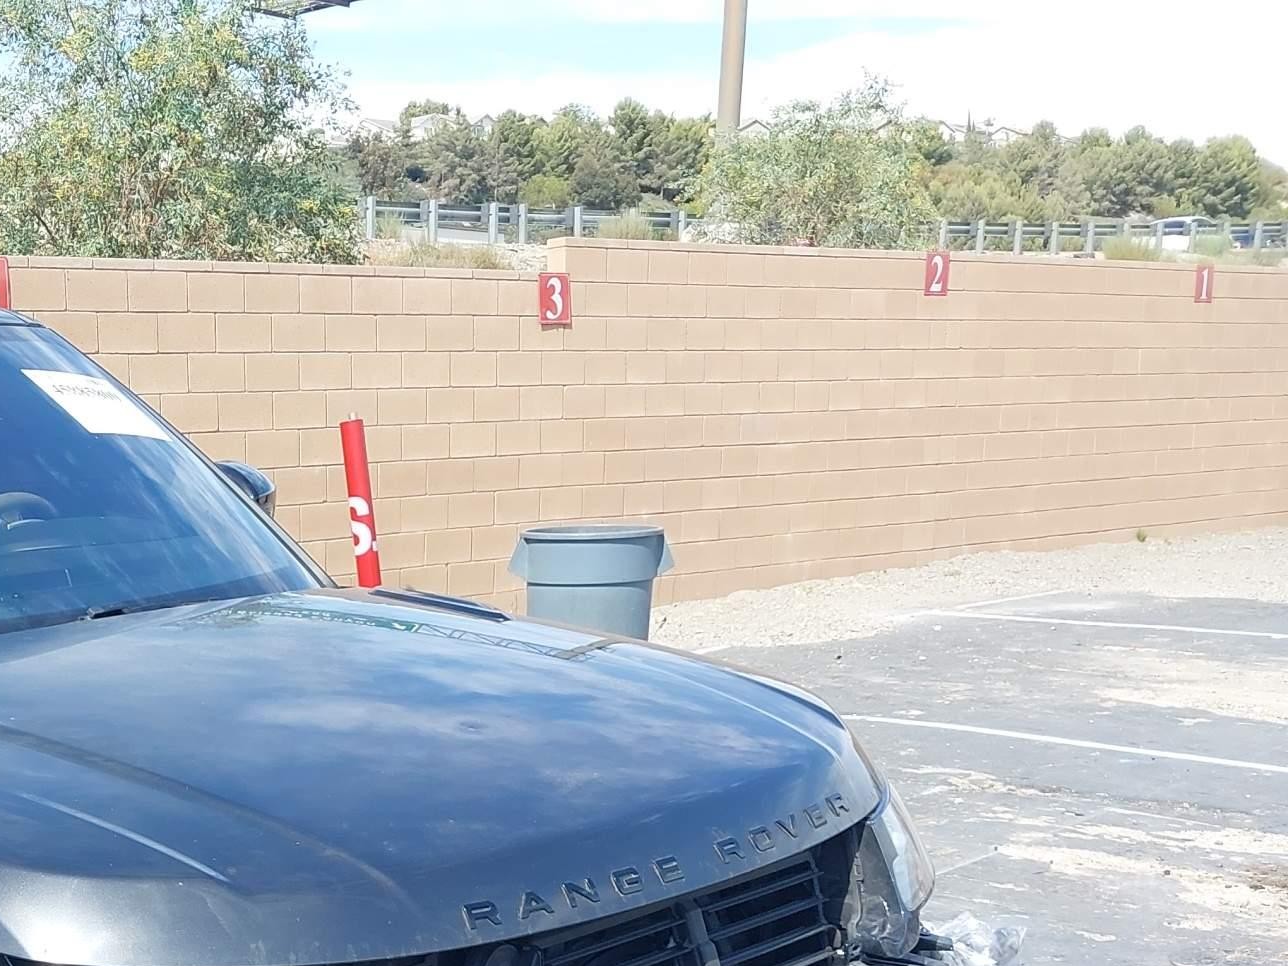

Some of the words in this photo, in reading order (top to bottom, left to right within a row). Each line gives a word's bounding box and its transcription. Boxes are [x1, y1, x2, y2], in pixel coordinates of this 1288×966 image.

[929, 255, 943, 292] 2
[1199, 268, 1209, 300] 1
[545, 276, 564, 320] 3
[461, 855, 686, 931] RANGE
[712, 792, 850, 864] ROVER
